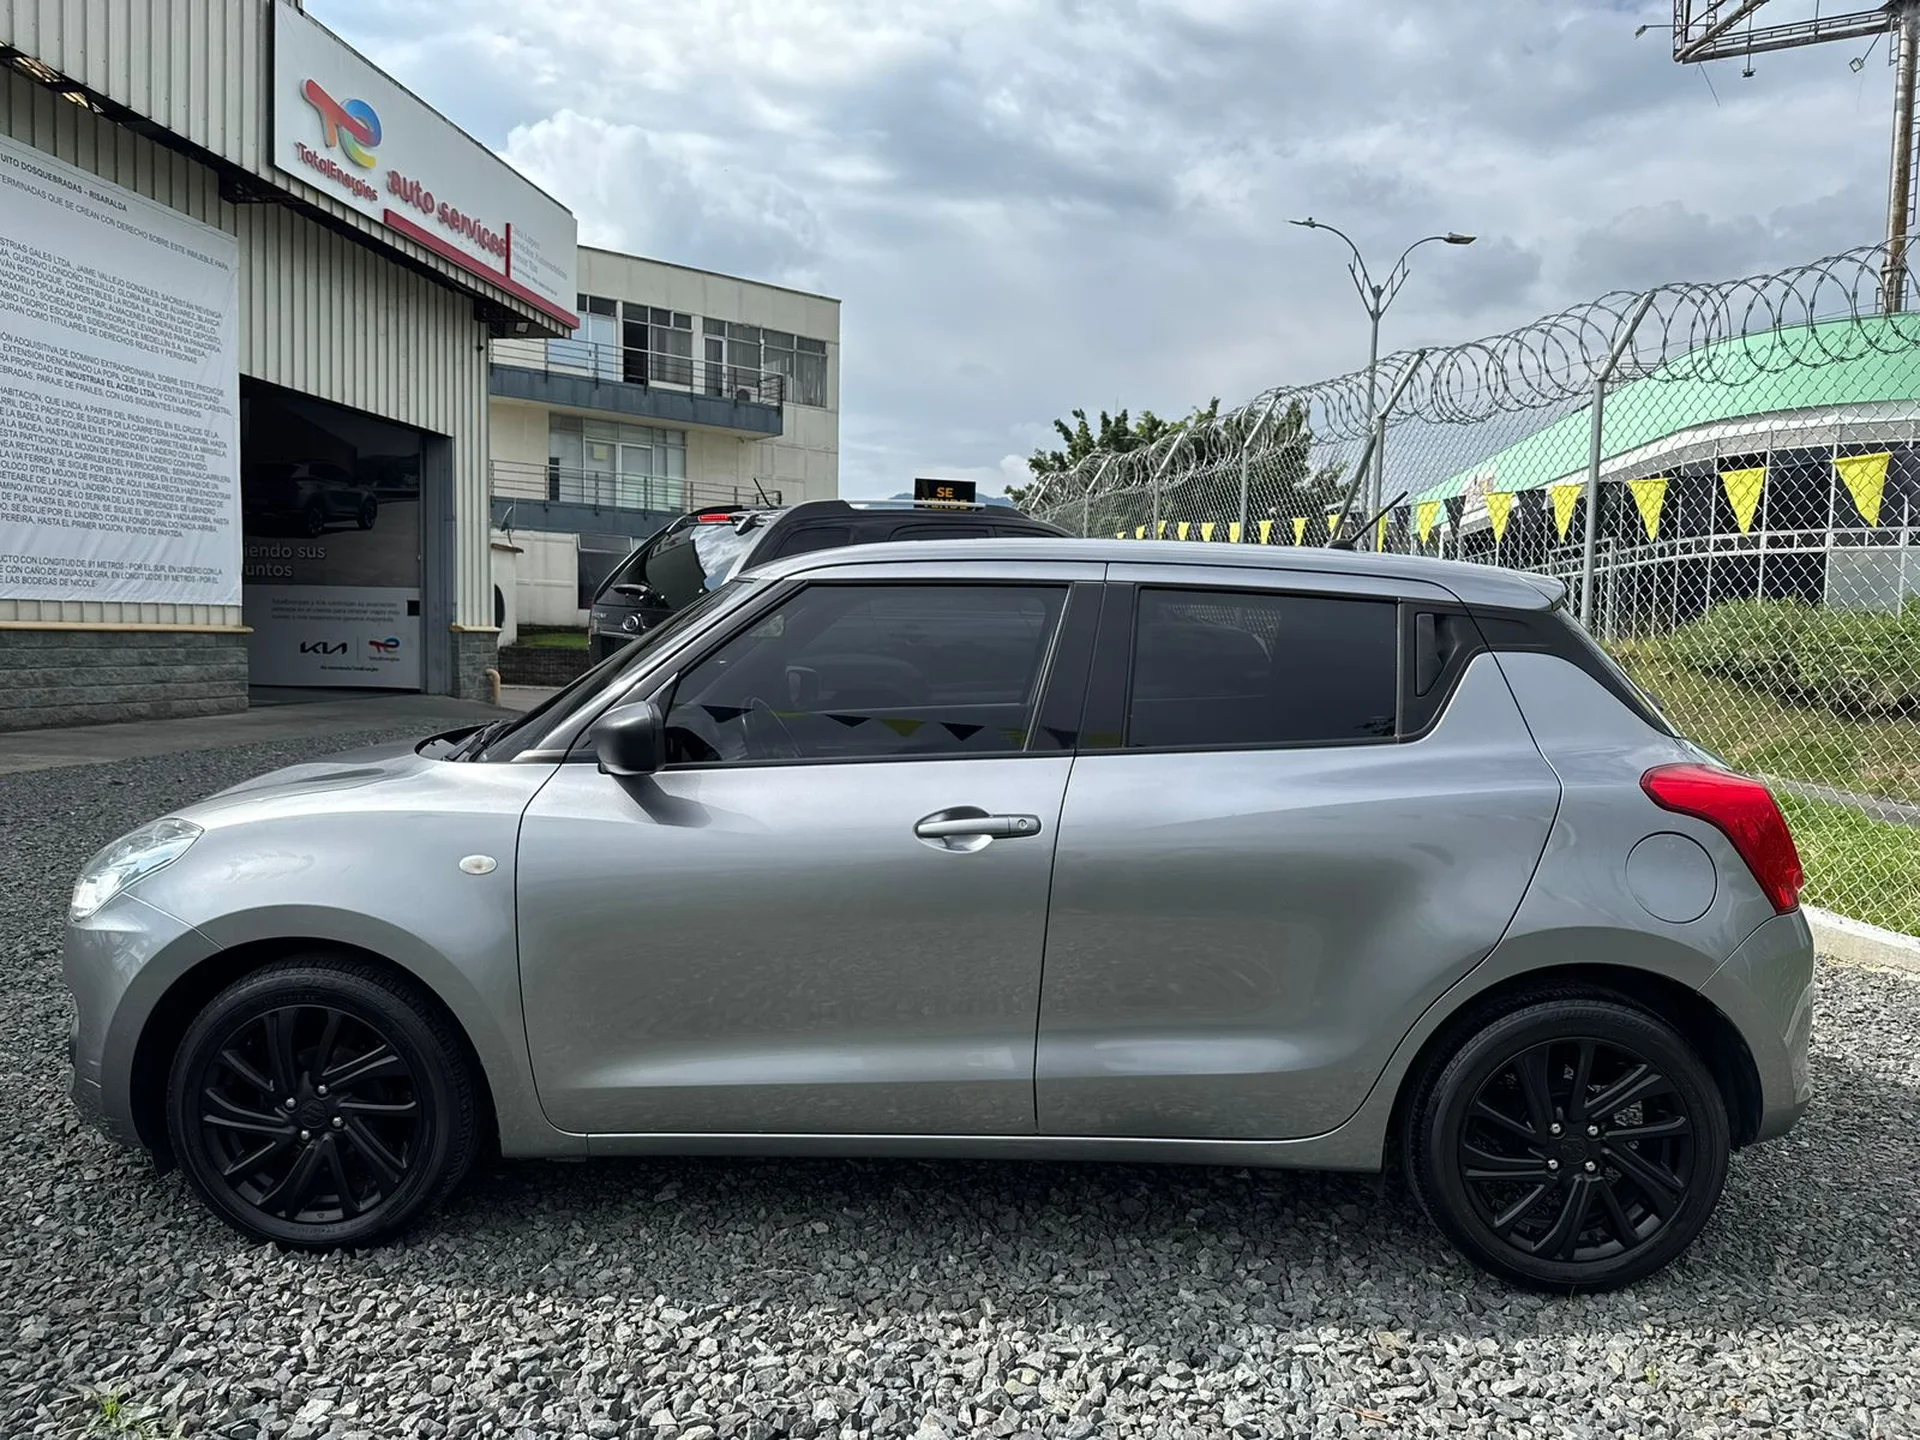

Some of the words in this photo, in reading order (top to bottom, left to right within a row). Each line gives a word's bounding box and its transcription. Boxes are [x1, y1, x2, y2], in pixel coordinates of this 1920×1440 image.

[1, 152, 19, 168] UITO
[21, 161, 81, 193] DOSQUEBRADAS
[295, 142, 378, 202] TotalEnergies
[48, 192, 62, 206] QUE
[64, 198, 73, 210] SE
[387, 169, 436, 215] auto
[437, 200, 506, 258] services
[0, 237, 27, 254] STRIAS
[12, 252, 46, 271] GUSTAVO
[48, 263, 82, 283] LONDOÑO
[17, 263, 34, 278] RICO
[0, 268, 29, 286] NADORA
[31, 278, 64, 297] POPULAR
[0, 289, 18, 303] ABIO
[20, 295, 48, 312] OSORIO
[39, 291, 75, 310] SOCIEDAD
[25, 308, 48, 322] COMO
[49, 314, 86, 333] TITULARES
[14, 335, 58, 355] ADQUISITIVA
[60, 347, 69, 358] DE
[2, 343, 44, 361] EXTENSIÓN
[45, 353, 92, 373] DENOMINADO
[10, 355, 52, 373] PROPIEDAD
[54, 366, 63, 376] DE
[36, 373, 62, 387] PARAJE
[64, 379, 73, 389] DE
[45, 395, 60, 406] QUE
[5, 407, 14, 417] LA
[45, 415, 59, 426] QUE
[61, 418, 86, 431] FIGURA
[20, 400, 33, 411] DEL
[34, 403, 38, 412] 2
[76, 412, 84, 421] SE
[6, 418, 16, 428] LA
[45, 426, 68, 437] HASTA
[71, 430, 79, 439] UN
[15, 441, 39, 452] RECTA
[40, 445, 65, 457] HASTA
[65, 449, 72, 458] LA
[60, 438, 72, 448] DEL
[0, 449, 9, 458] LA
[11, 450, 23, 460] VIA
[57, 458, 65, 467] SE
[67, 460, 88, 470] SIGUE
[1, 459, 27, 471] OLOCO
[29, 463, 49, 474] OTRO
[52, 467, 76, 478] MOJON
[36, 475, 46, 484] DE
[48, 477, 56, 485] LA
[1, 491, 10, 500] DE
[32, 495, 55, 505] HASTA
[57, 498, 65, 507] EL
[68, 499, 79, 508] RIO
[23, 484, 55, 496] ANTIGUO
[57, 488, 72, 498] QUE
[73, 490, 82, 499] LO
[936, 486, 954, 498] SE
[11, 503, 19, 511] SE
[22, 504, 45, 514] SIGUE
[47, 507, 62, 516] POR
[64, 509, 72, 517] EL
[37, 516, 60, 526] HASTA
[61, 518, 68, 527] EL
[297, 546, 326, 558] sus
[20, 555, 37, 564] CON
[39, 556, 74, 566] LONGITUD
[76, 559, 86, 567] DE
[245, 563, 293, 576] untos
[5, 564, 22, 573] CON
[25, 565, 46, 574] CAÑO
[47, 566, 57, 575] DE
[59, 567, 82, 576] AGUAS
[5, 575, 19, 584] LAS
[22, 576, 57, 585] BODEGAS
[59, 578, 68, 586] DE
[300, 641, 348, 654] KIA
